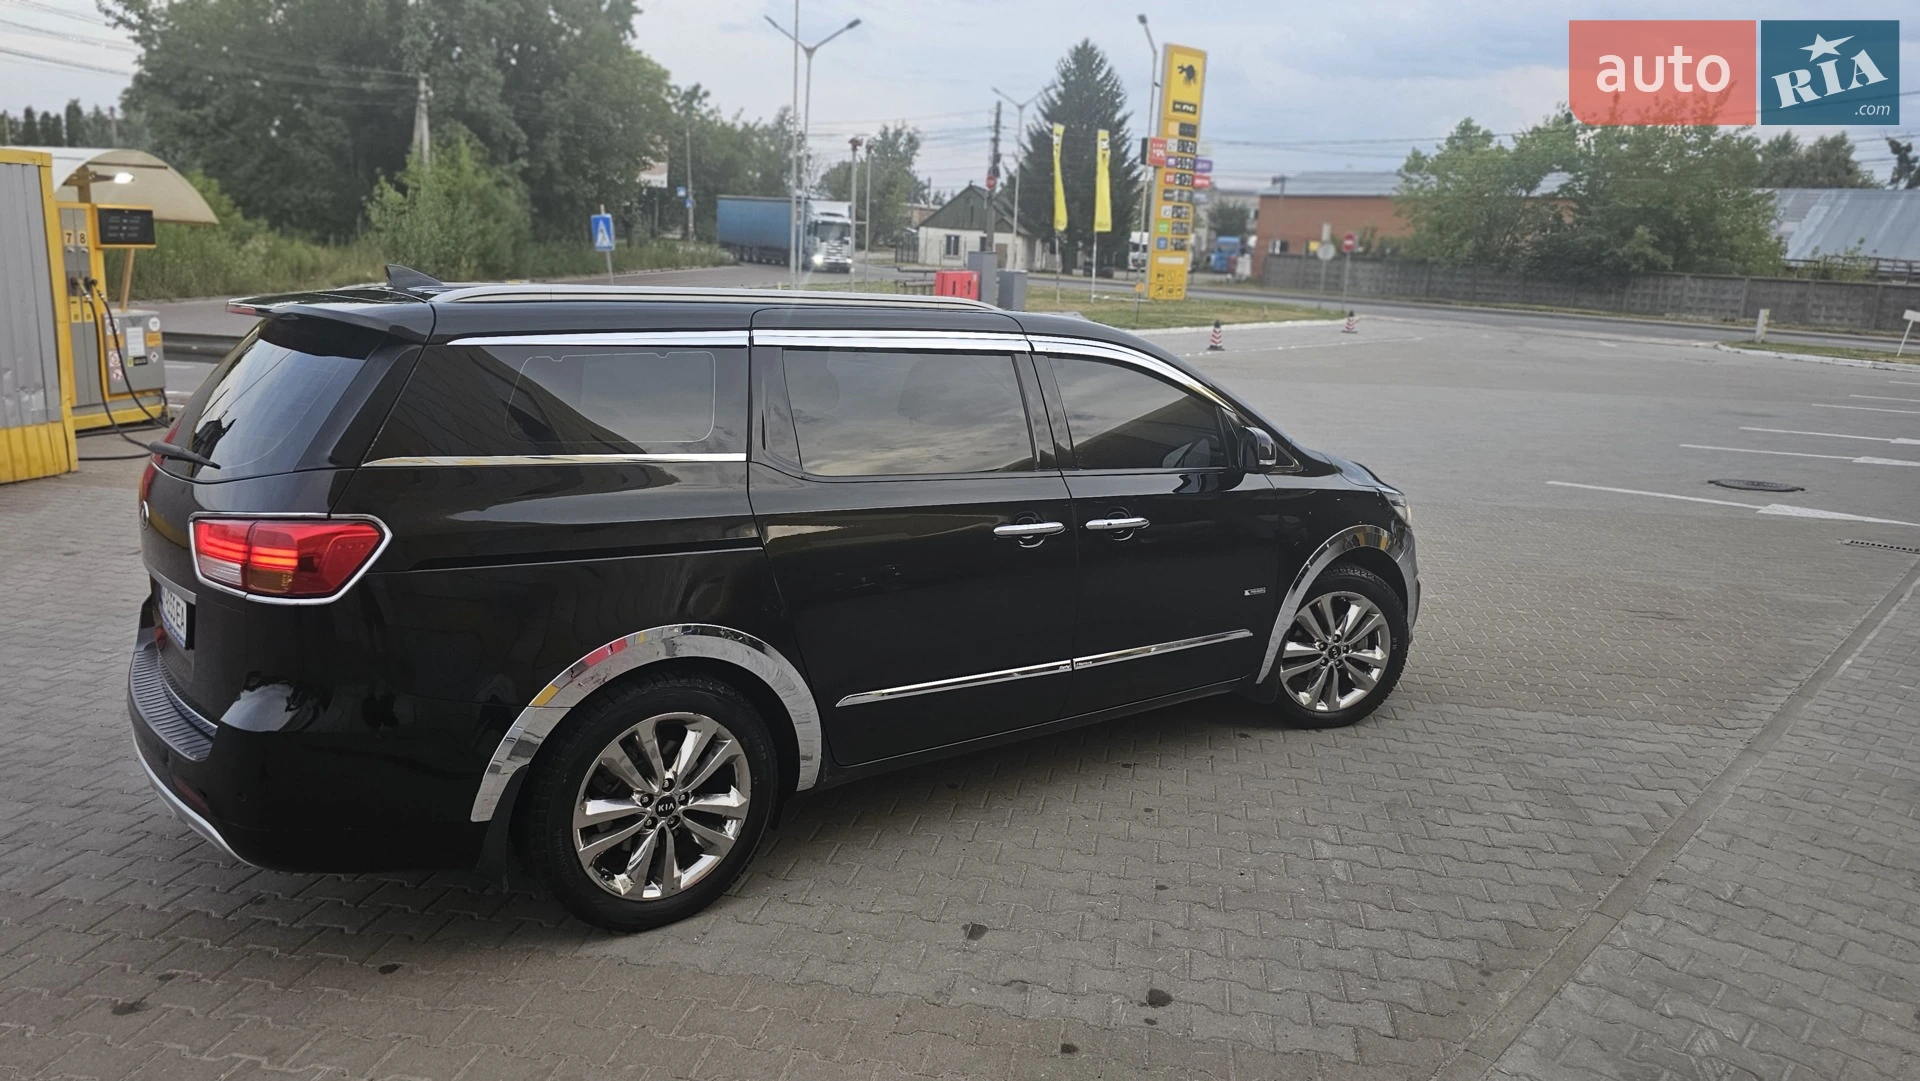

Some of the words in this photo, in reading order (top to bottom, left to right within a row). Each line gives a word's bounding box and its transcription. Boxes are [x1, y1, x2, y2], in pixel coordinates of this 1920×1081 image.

[66, 233, 73, 244] 7
[79, 233, 86, 244] 8
[658, 802, 675, 812] KIA
